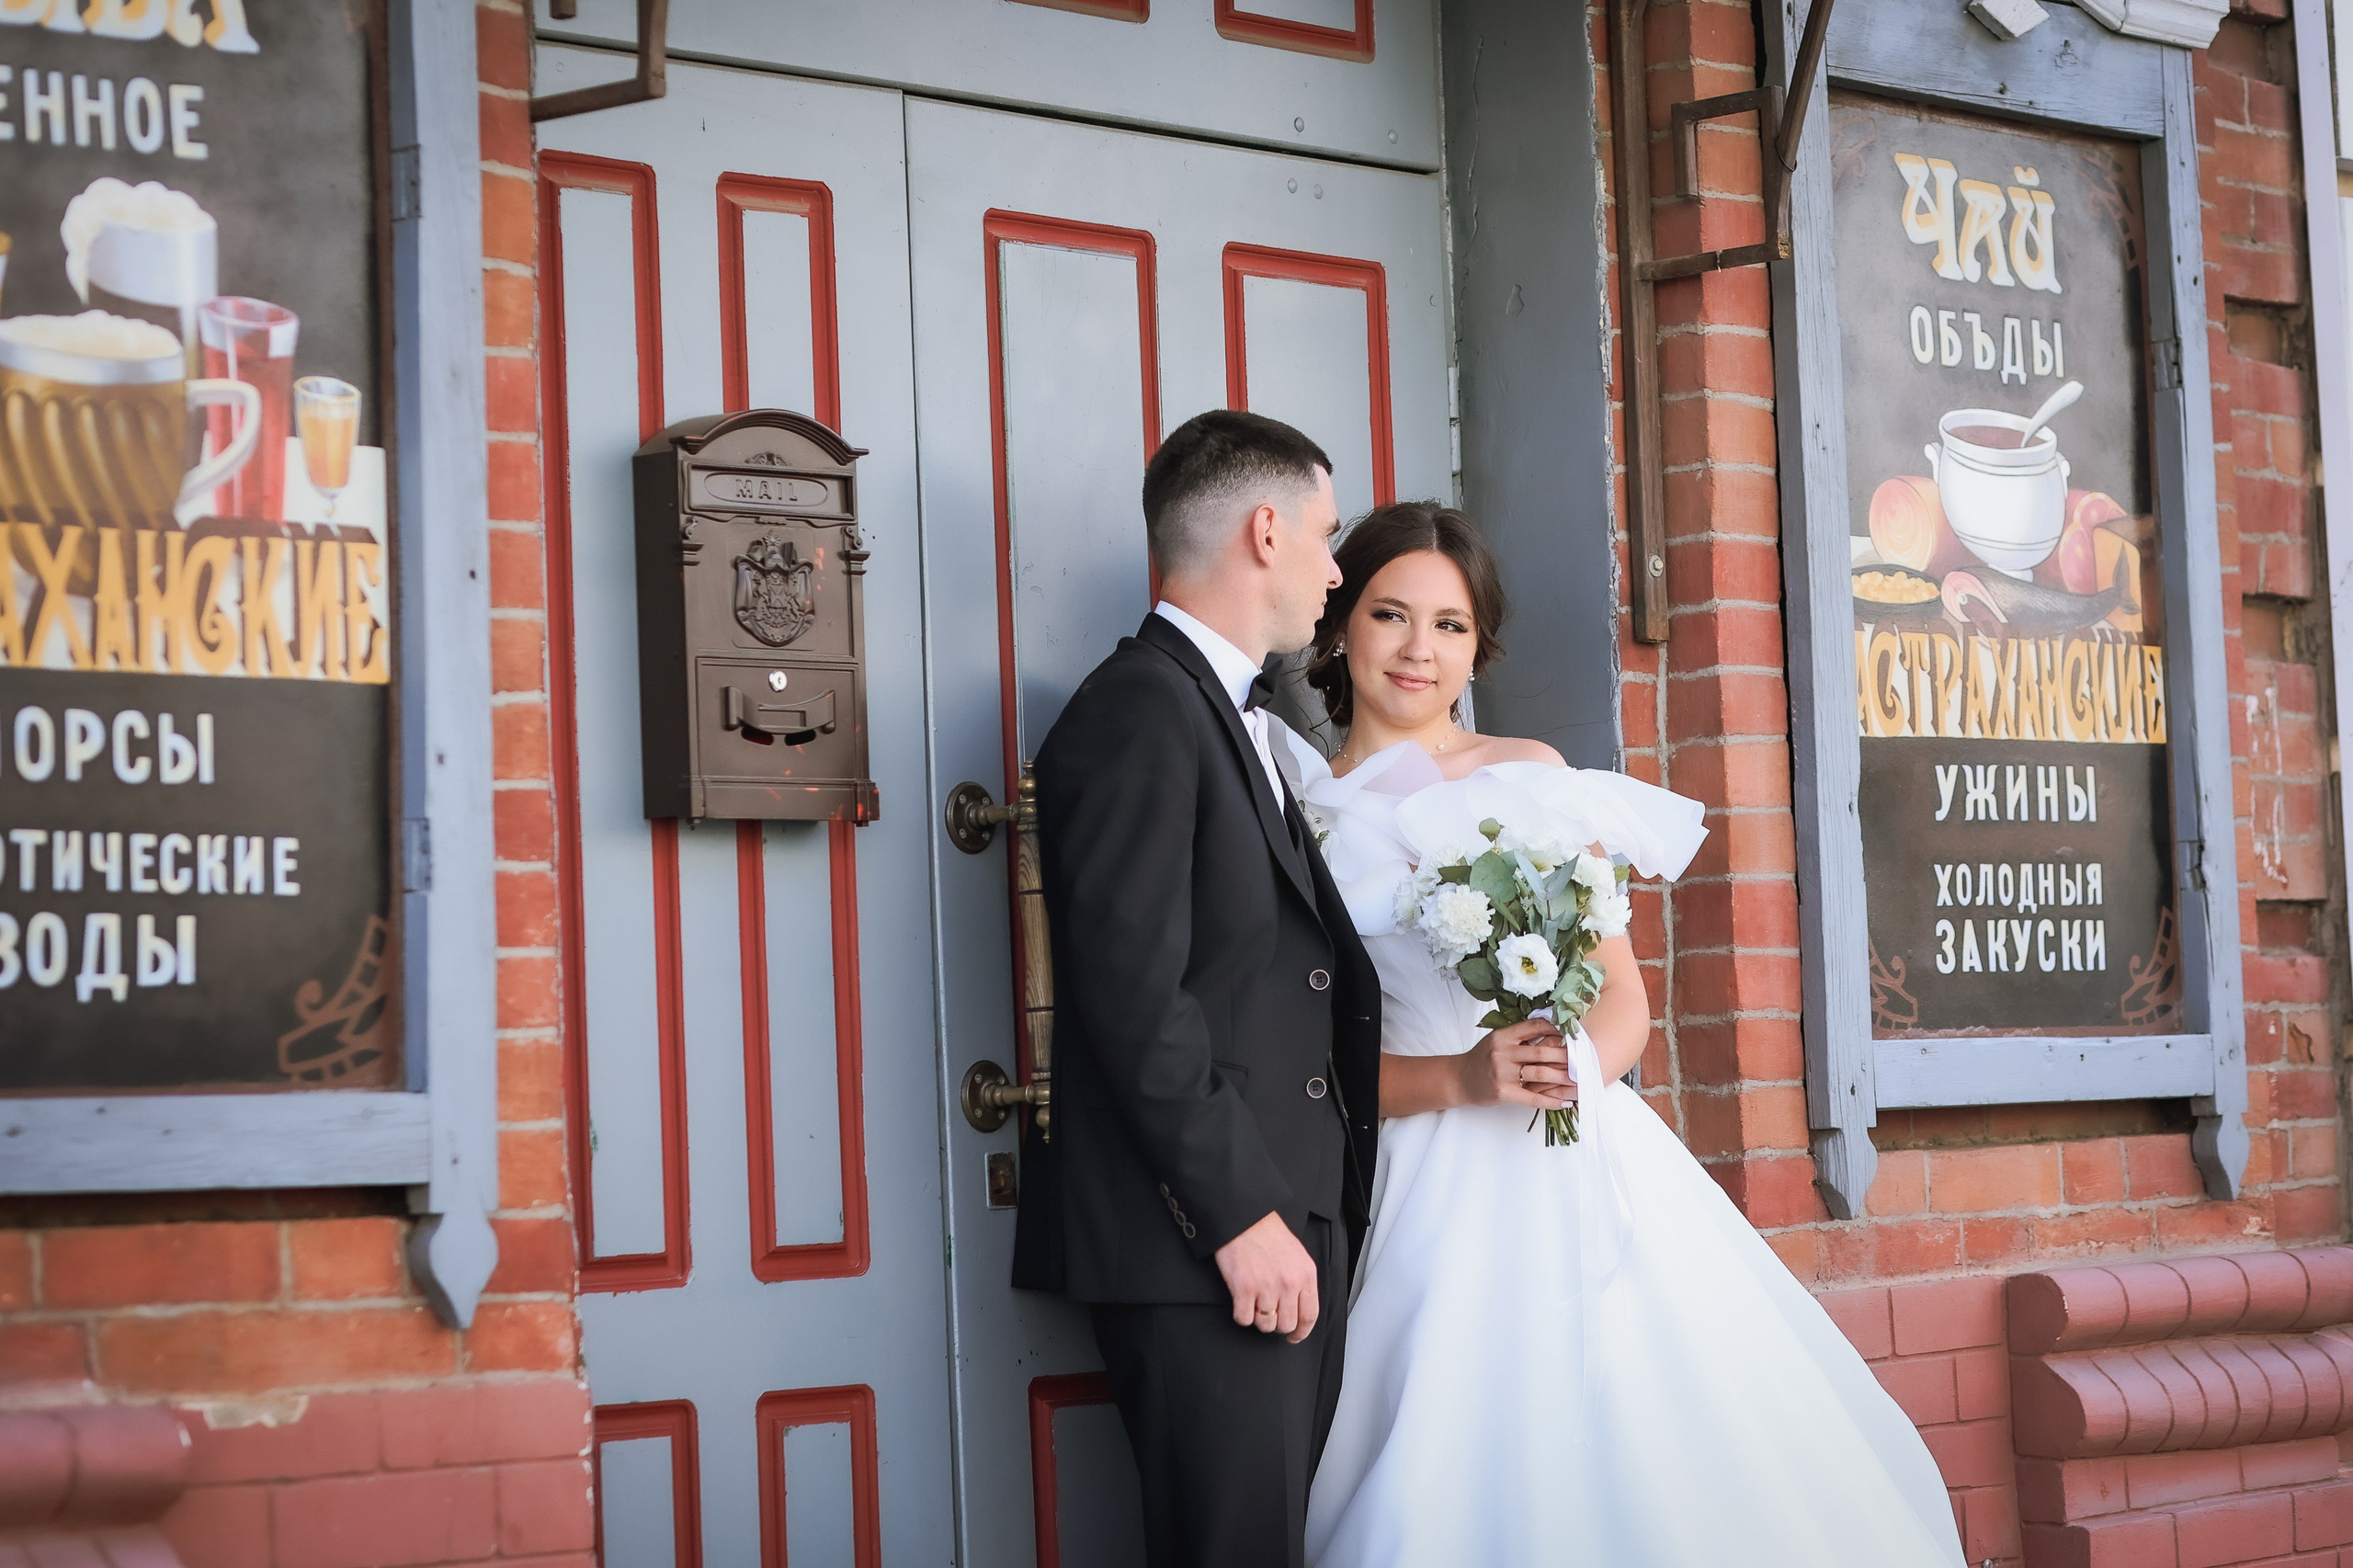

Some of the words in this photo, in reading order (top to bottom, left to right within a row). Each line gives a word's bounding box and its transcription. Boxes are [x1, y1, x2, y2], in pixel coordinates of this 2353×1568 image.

[1894, 152, 2063, 295] ЧАЙ
[735, 477, 799, 502] MAIL
[0, 705, 216, 785] ОРСЫ
[1934, 764, 2097, 823] УЖИНЫ
[0, 828, 301, 897] ТИЧЕСКИЕ
[1933, 863, 2104, 915] ХОЛОДНЫЯ
[1934, 918, 2108, 975] ЗАКУСКИ
